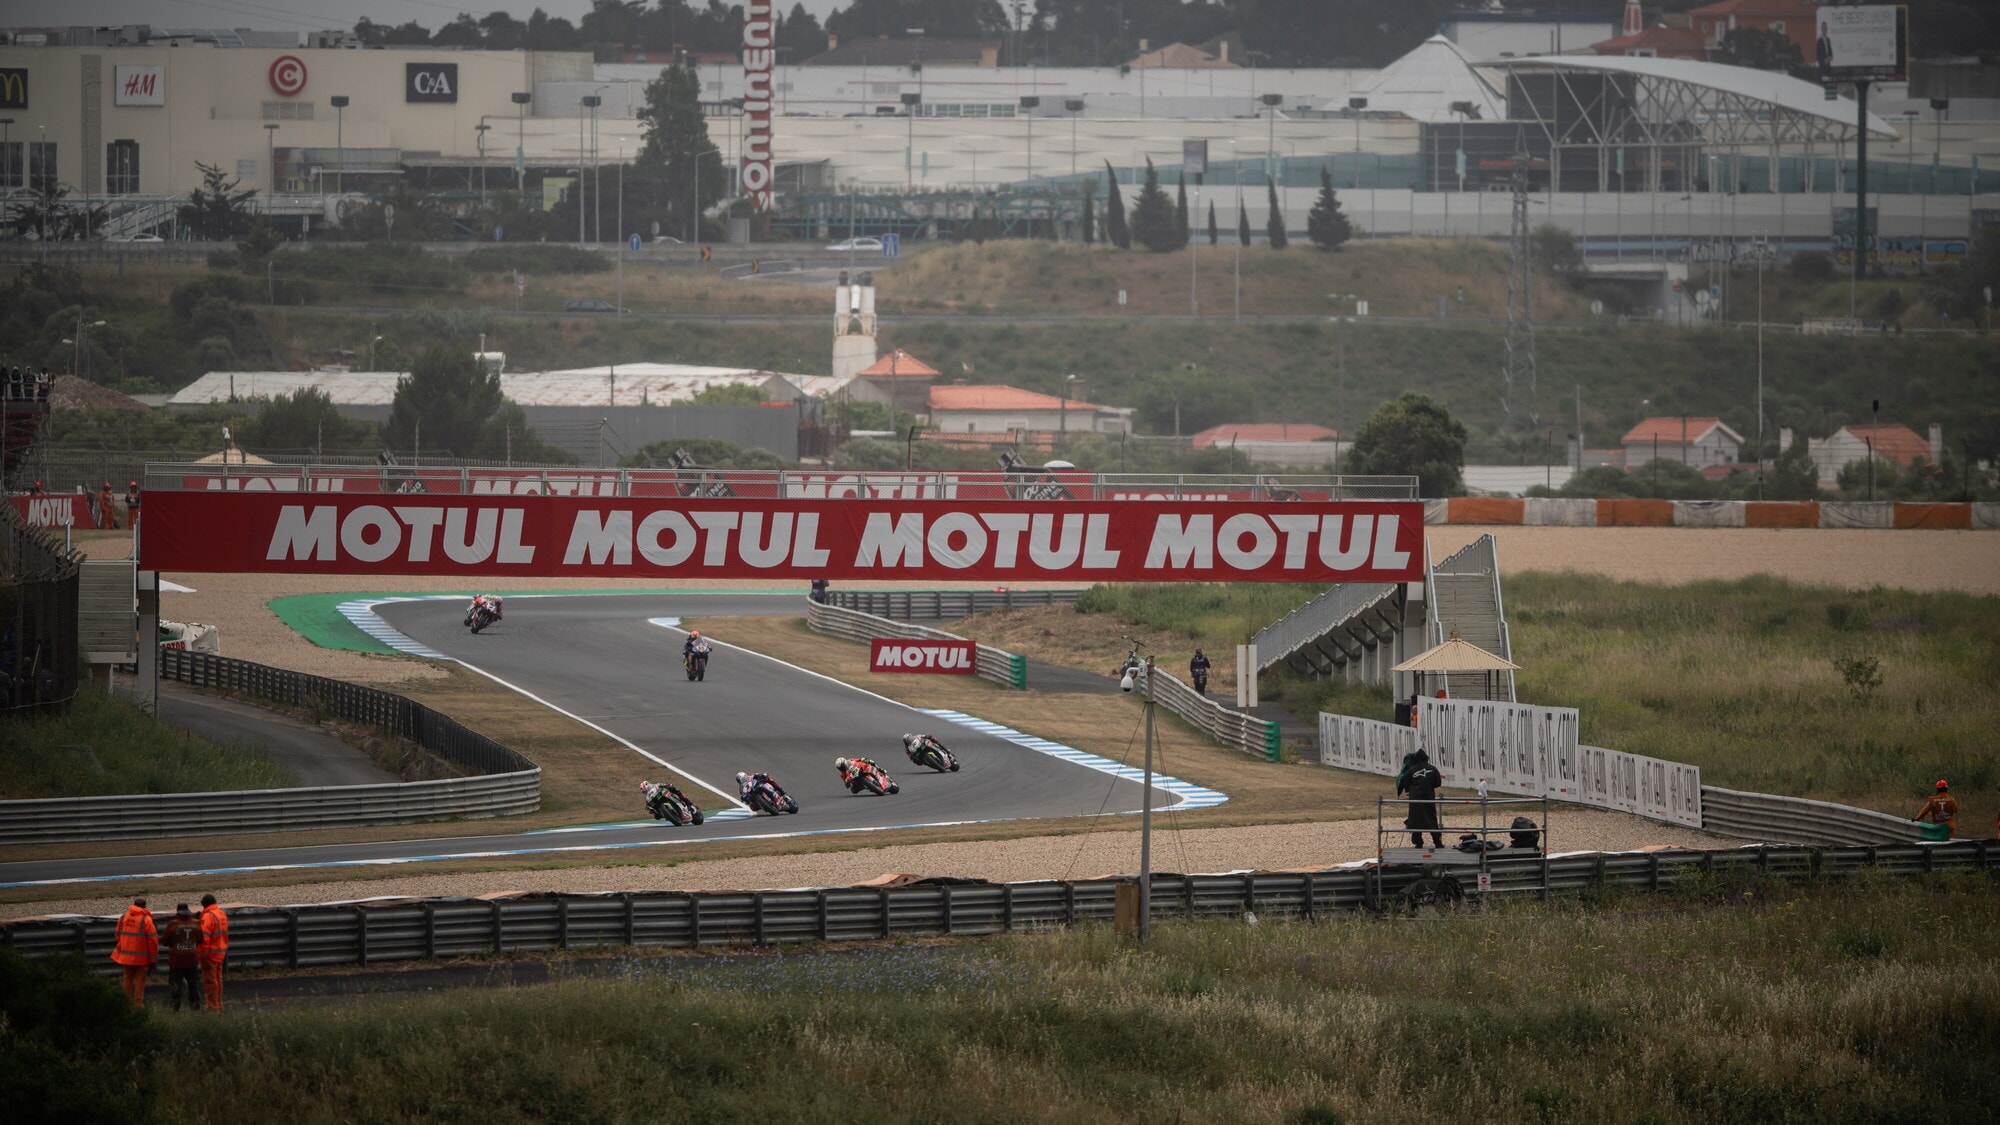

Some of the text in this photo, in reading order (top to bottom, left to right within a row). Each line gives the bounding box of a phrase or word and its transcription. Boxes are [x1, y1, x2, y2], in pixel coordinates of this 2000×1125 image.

[125, 74, 156, 96] H&M
[414, 72, 452, 94] C&A
[27, 498, 75, 527] MOTUL
[266, 505, 1411, 571] MOTUL MOTUL MOTUL MOTUL
[876, 646, 971, 669] MOTUL
